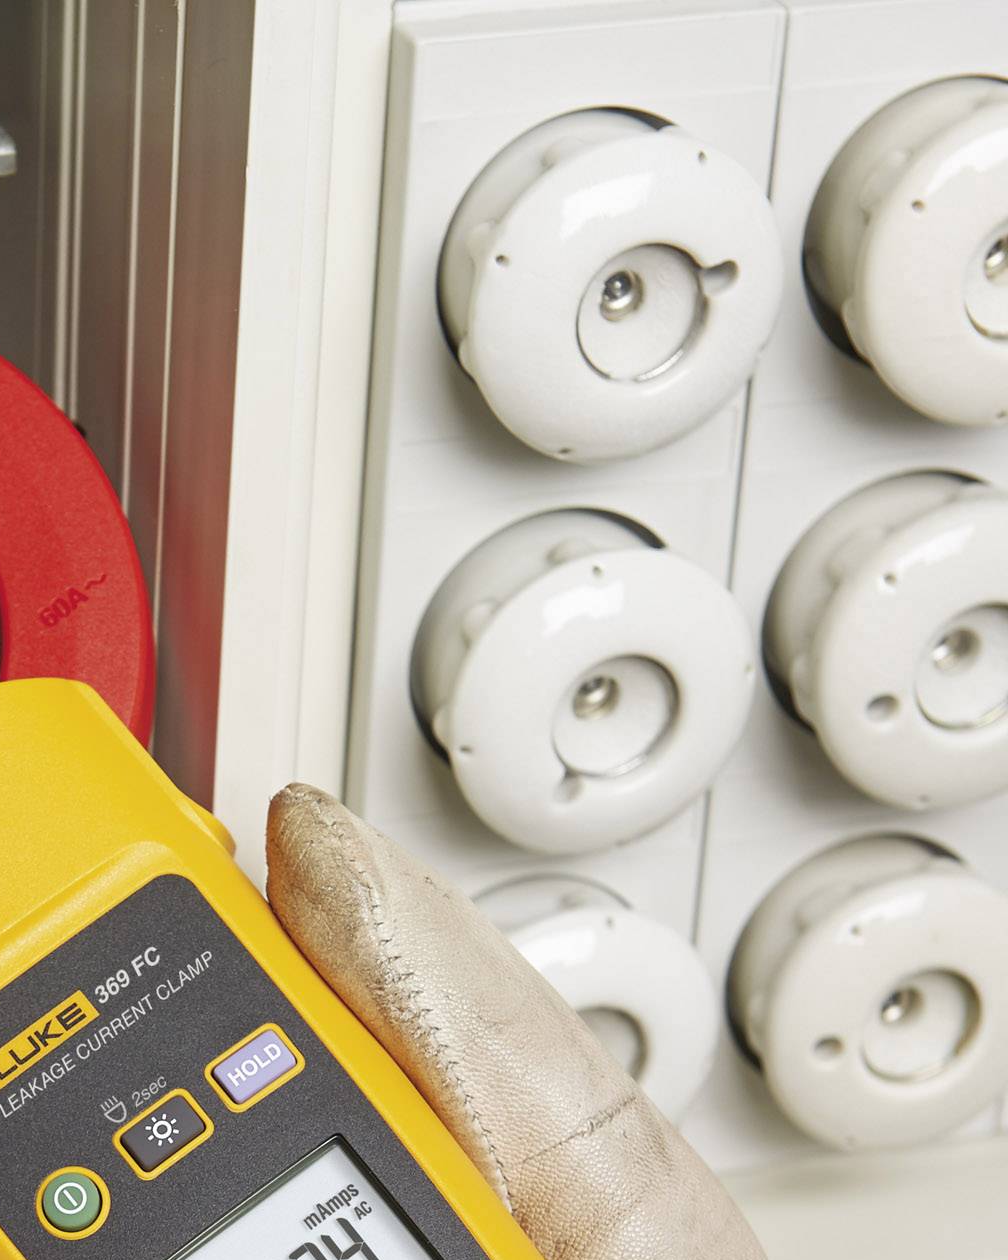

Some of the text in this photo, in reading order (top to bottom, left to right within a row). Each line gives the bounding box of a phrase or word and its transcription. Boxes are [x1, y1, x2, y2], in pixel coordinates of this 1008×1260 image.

[95, 971, 130, 1005] 369
[131, 946, 161, 977] FC
[0, 1052, 76, 1121] LEAKAGE
[76, 994, 154, 1060] CURRENT
[157, 950, 215, 1002] CLAMP
[227, 1043, 282, 1088] HOLD
[131, 1074, 168, 1108] 2sec
[304, 1181, 360, 1231] mAmps
[353, 1202, 373, 1220] AC
